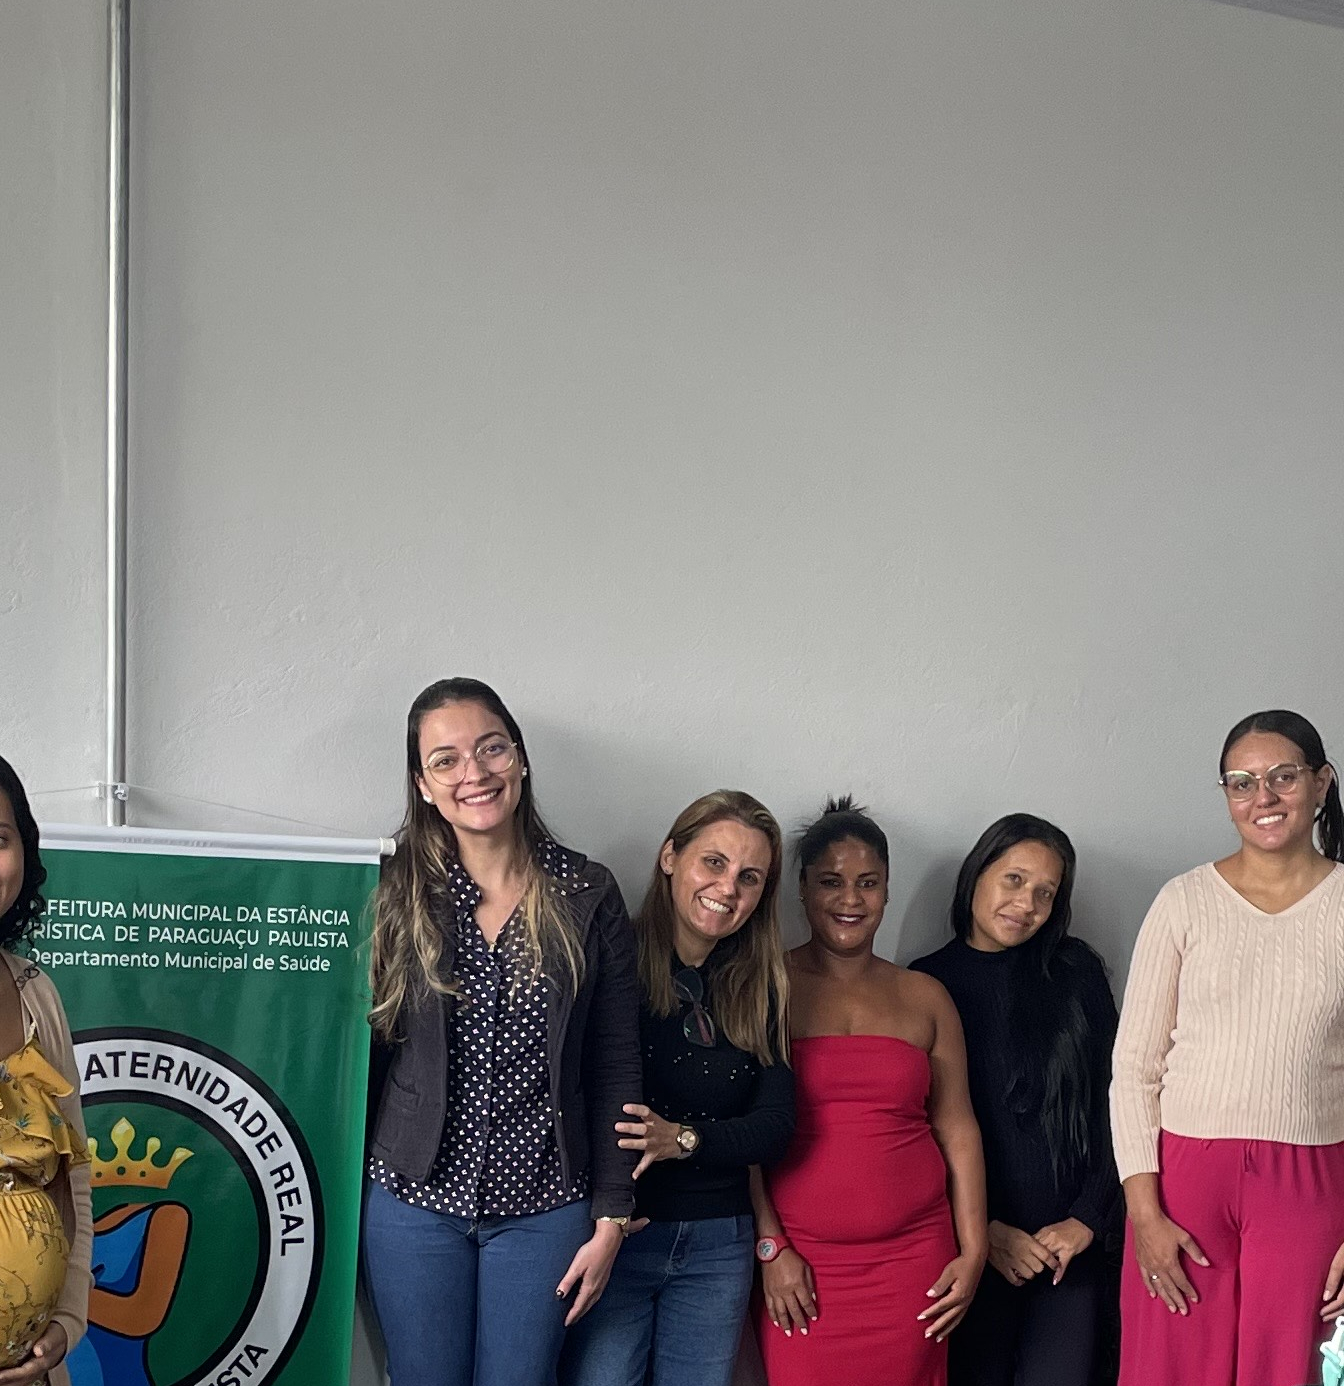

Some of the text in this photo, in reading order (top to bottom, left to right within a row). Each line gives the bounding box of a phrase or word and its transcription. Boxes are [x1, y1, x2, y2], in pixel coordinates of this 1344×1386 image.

[40, 899, 351, 926] FEITURA MUNICIPAL DA ESTÂNCIA
[30, 918, 349, 950] RÍSTICA DE PARAGUAÇU PAULISTA
[165, 951, 247, 972] Municipal
[252, 953, 275, 971] de
[279, 954, 331, 972] Saúde
[84, 1050, 305, 1257] ATERNIDADE REAL
